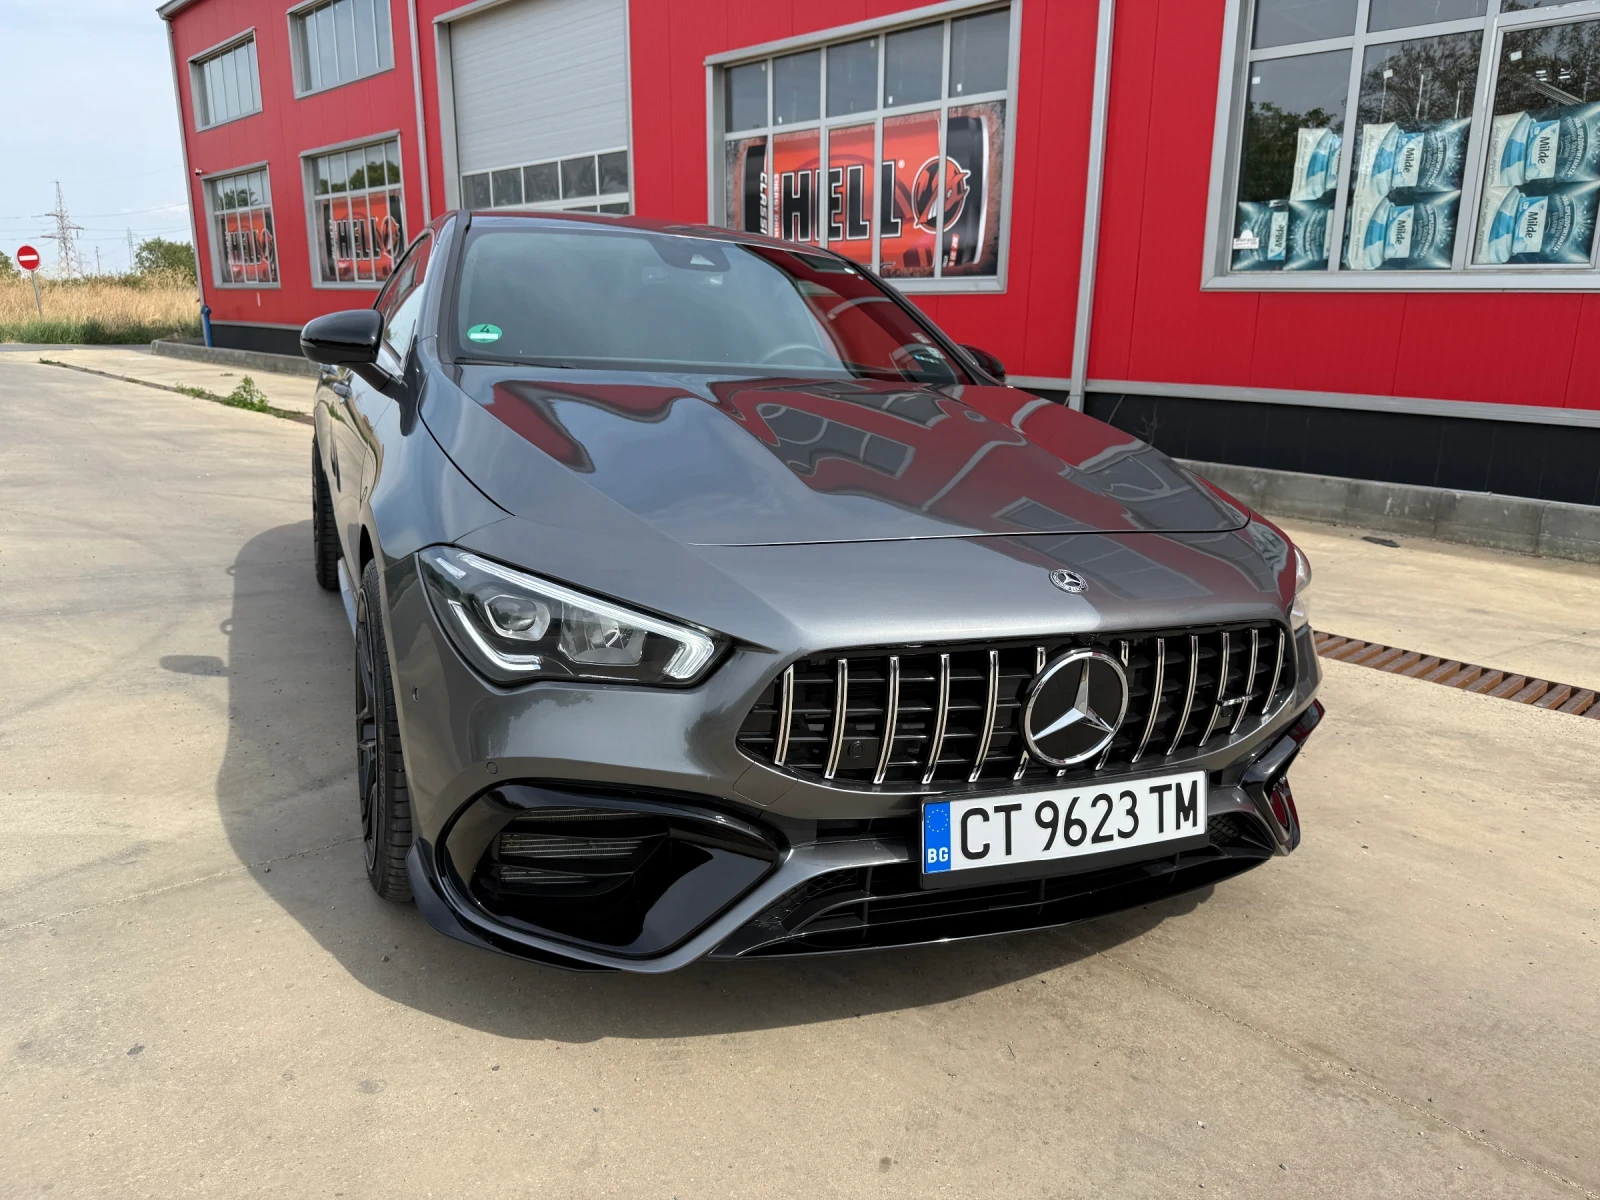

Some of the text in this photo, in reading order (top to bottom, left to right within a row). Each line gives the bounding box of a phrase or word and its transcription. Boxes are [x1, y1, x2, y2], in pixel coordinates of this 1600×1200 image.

[1403, 147, 1415, 173] Milde
[1538, 136, 1550, 164] Milde
[781, 160, 901, 242] HELL
[337, 217, 381, 260] HELL
[1274, 224, 1285, 248] Milde
[1395, 219, 1406, 245] Milde
[1525, 211, 1538, 239] Milde
[231, 230, 262, 265] HELL
[479, 324, 491, 334] 4
[960, 780, 1198, 860] CT 9623 TM
[927, 847, 949, 864] BG
